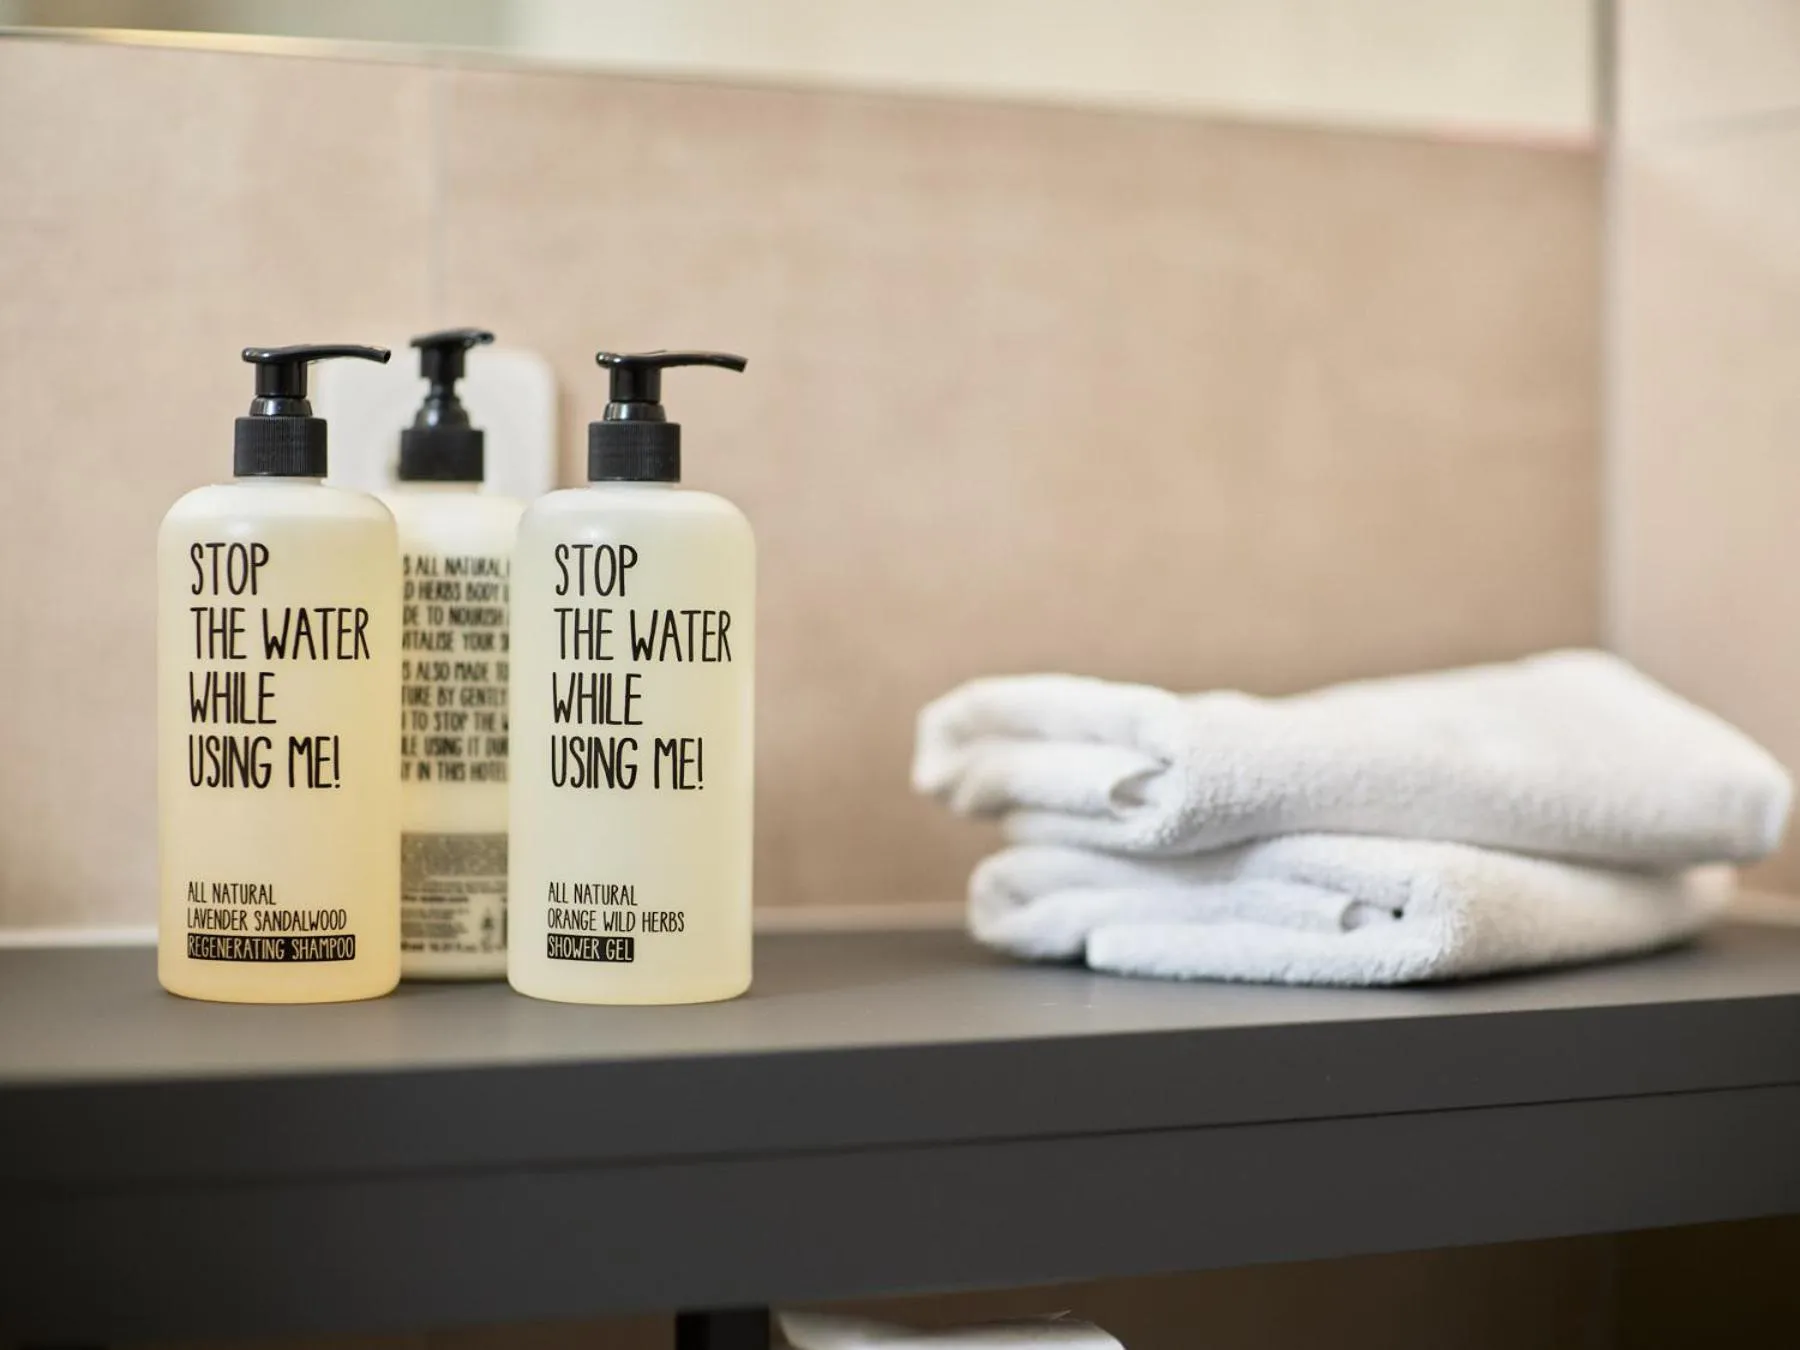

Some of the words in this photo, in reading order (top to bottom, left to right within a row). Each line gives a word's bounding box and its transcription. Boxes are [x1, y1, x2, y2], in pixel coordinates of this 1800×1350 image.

[190, 542, 269, 596] STOP
[416, 555, 438, 577] ALL
[555, 544, 638, 597] STOP
[418, 580, 461, 602] HERBS
[466, 581, 498, 602] BODY
[426, 605, 444, 625] TO
[449, 606, 504, 627] NOURISH
[191, 607, 247, 660] THE
[262, 607, 371, 660] WATER
[463, 632, 494, 652] YOUR
[554, 608, 614, 661] THE
[630, 609, 732, 662] WATER
[416, 660, 450, 682] ALSO
[454, 660, 489, 683] MADE
[189, 671, 277, 724] WHILE
[437, 687, 455, 707] BY
[552, 672, 643, 725] WHILE
[412, 710, 428, 731] TO
[434, 711, 468, 732] STOP
[474, 712, 496, 732] THE
[424, 736, 462, 758] USING
[468, 736, 479, 757] IT
[188, 736, 272, 788] USING
[289, 736, 341, 789] ME!
[417, 761, 431, 782] IN
[438, 761, 465, 782] THIS
[552, 737, 638, 790] USING
[655, 738, 704, 790] ME!
[187, 881, 207, 903] ALL
[212, 883, 276, 905] NATURAL
[548, 882, 568, 904] ALL
[574, 883, 638, 906] NATURAL
[187, 908, 248, 931] LAVENDER
[254, 909, 347, 931] SANDALWOOD
[547, 908, 597, 931] ORANGE
[603, 911, 636, 932] WILD
[642, 911, 685, 932] HERBS
[188, 935, 285, 960] REGENERATING
[292, 937, 355, 960] SHAMPOO
[548, 935, 600, 960] SHOWER
[606, 938, 632, 961] GEL
